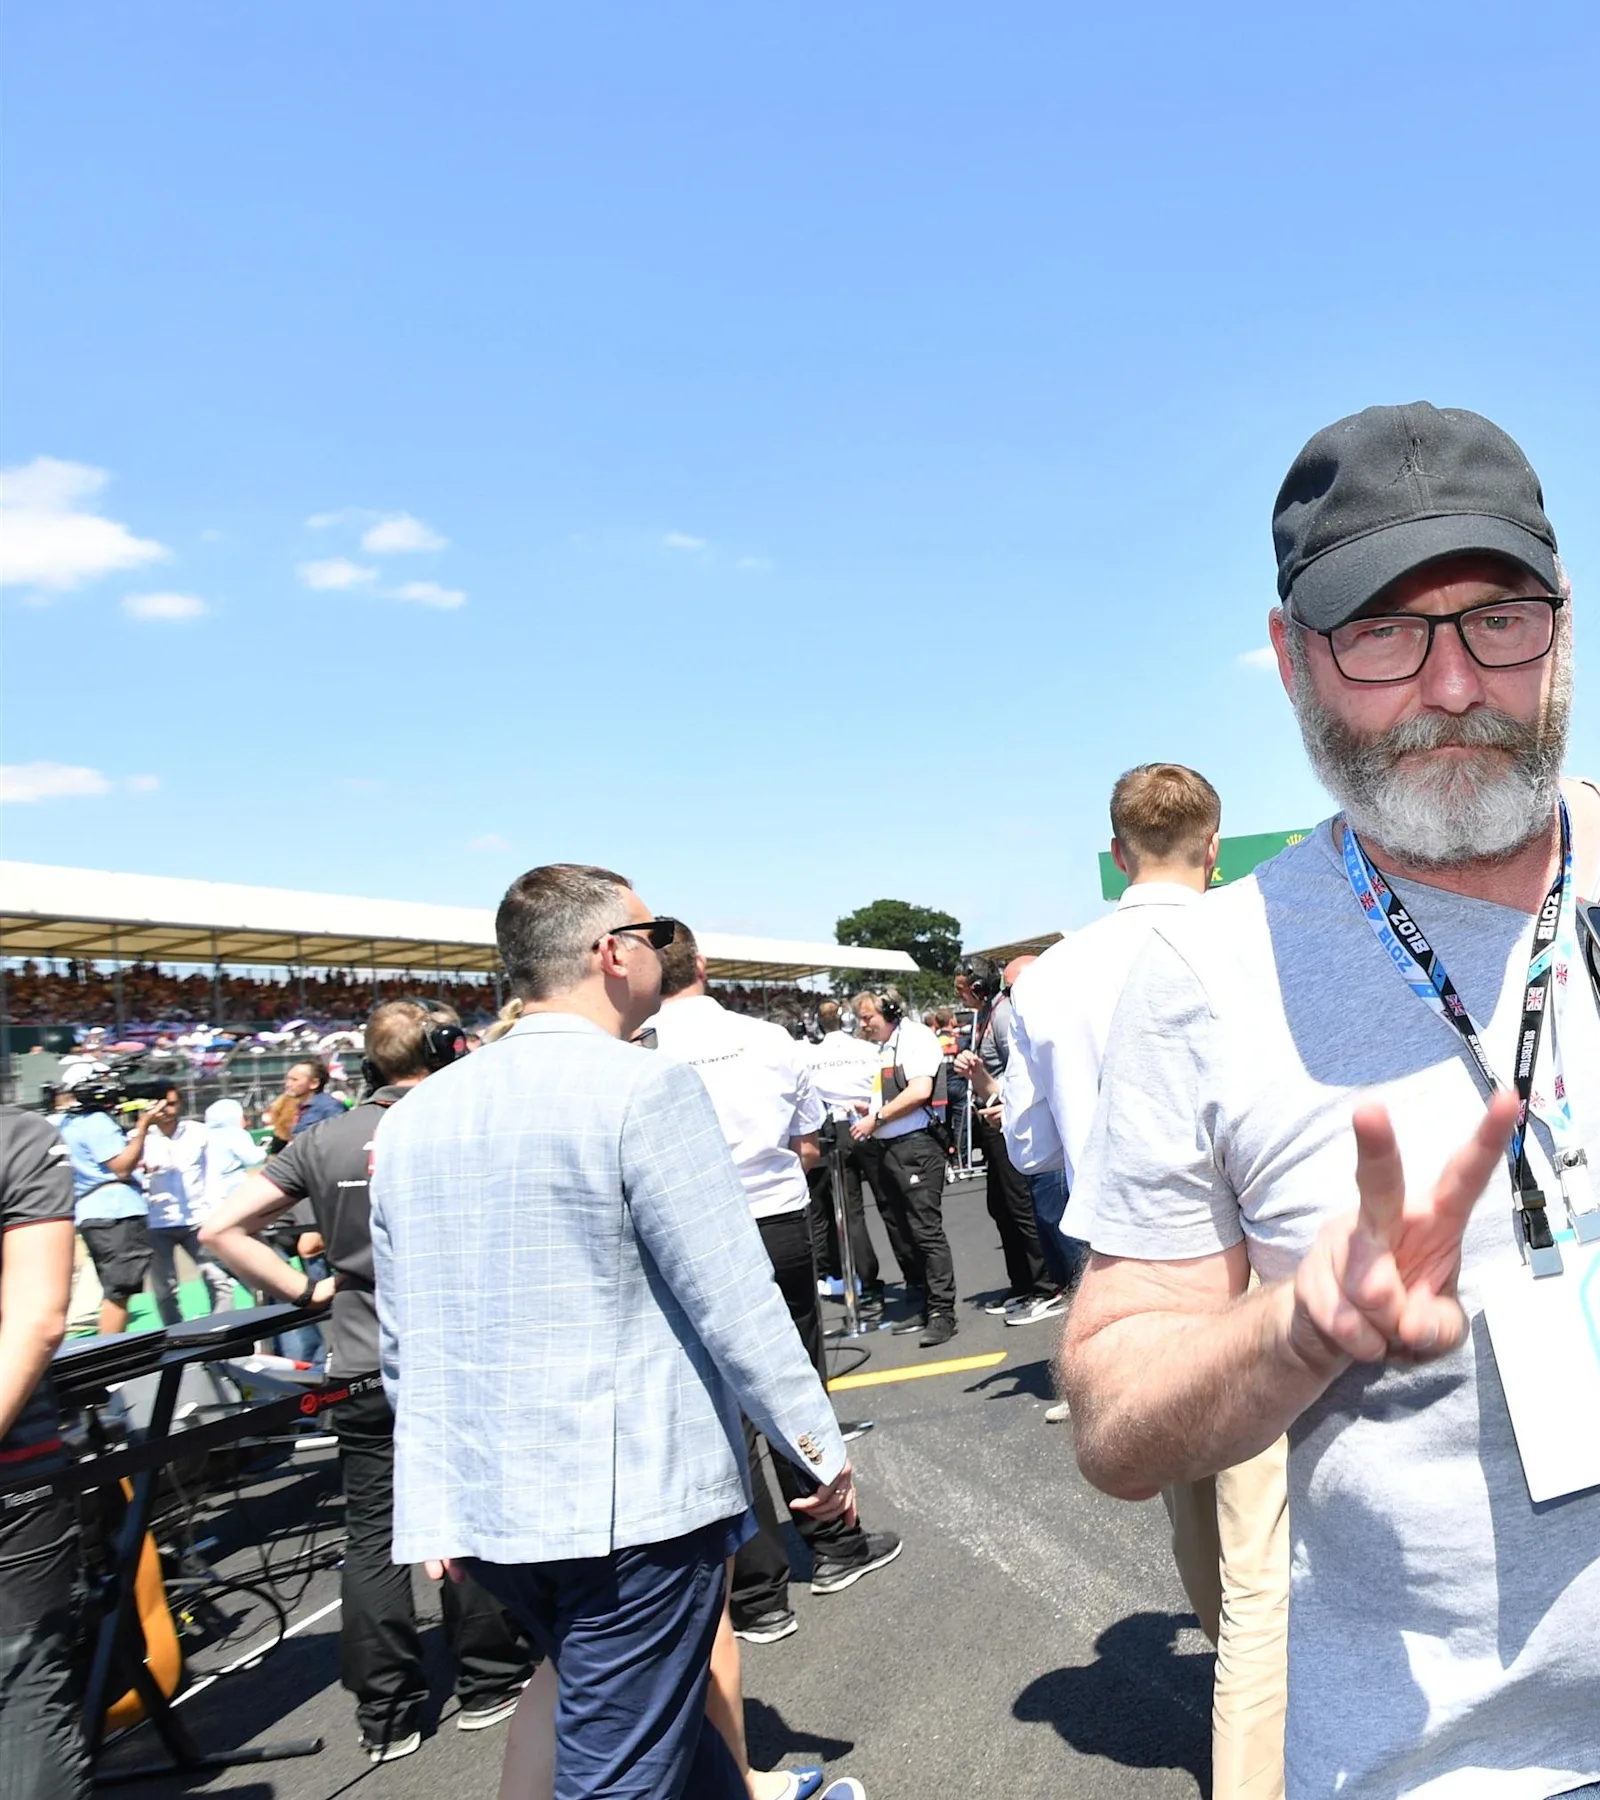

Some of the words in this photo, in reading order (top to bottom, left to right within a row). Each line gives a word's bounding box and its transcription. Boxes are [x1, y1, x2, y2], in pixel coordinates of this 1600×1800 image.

[1389, 908, 1431, 954] 2018
[1537, 892, 1561, 940] 2018
[1377, 926, 1413, 973] 2018
[1519, 1029, 1537, 1079] SILVERSTONE
